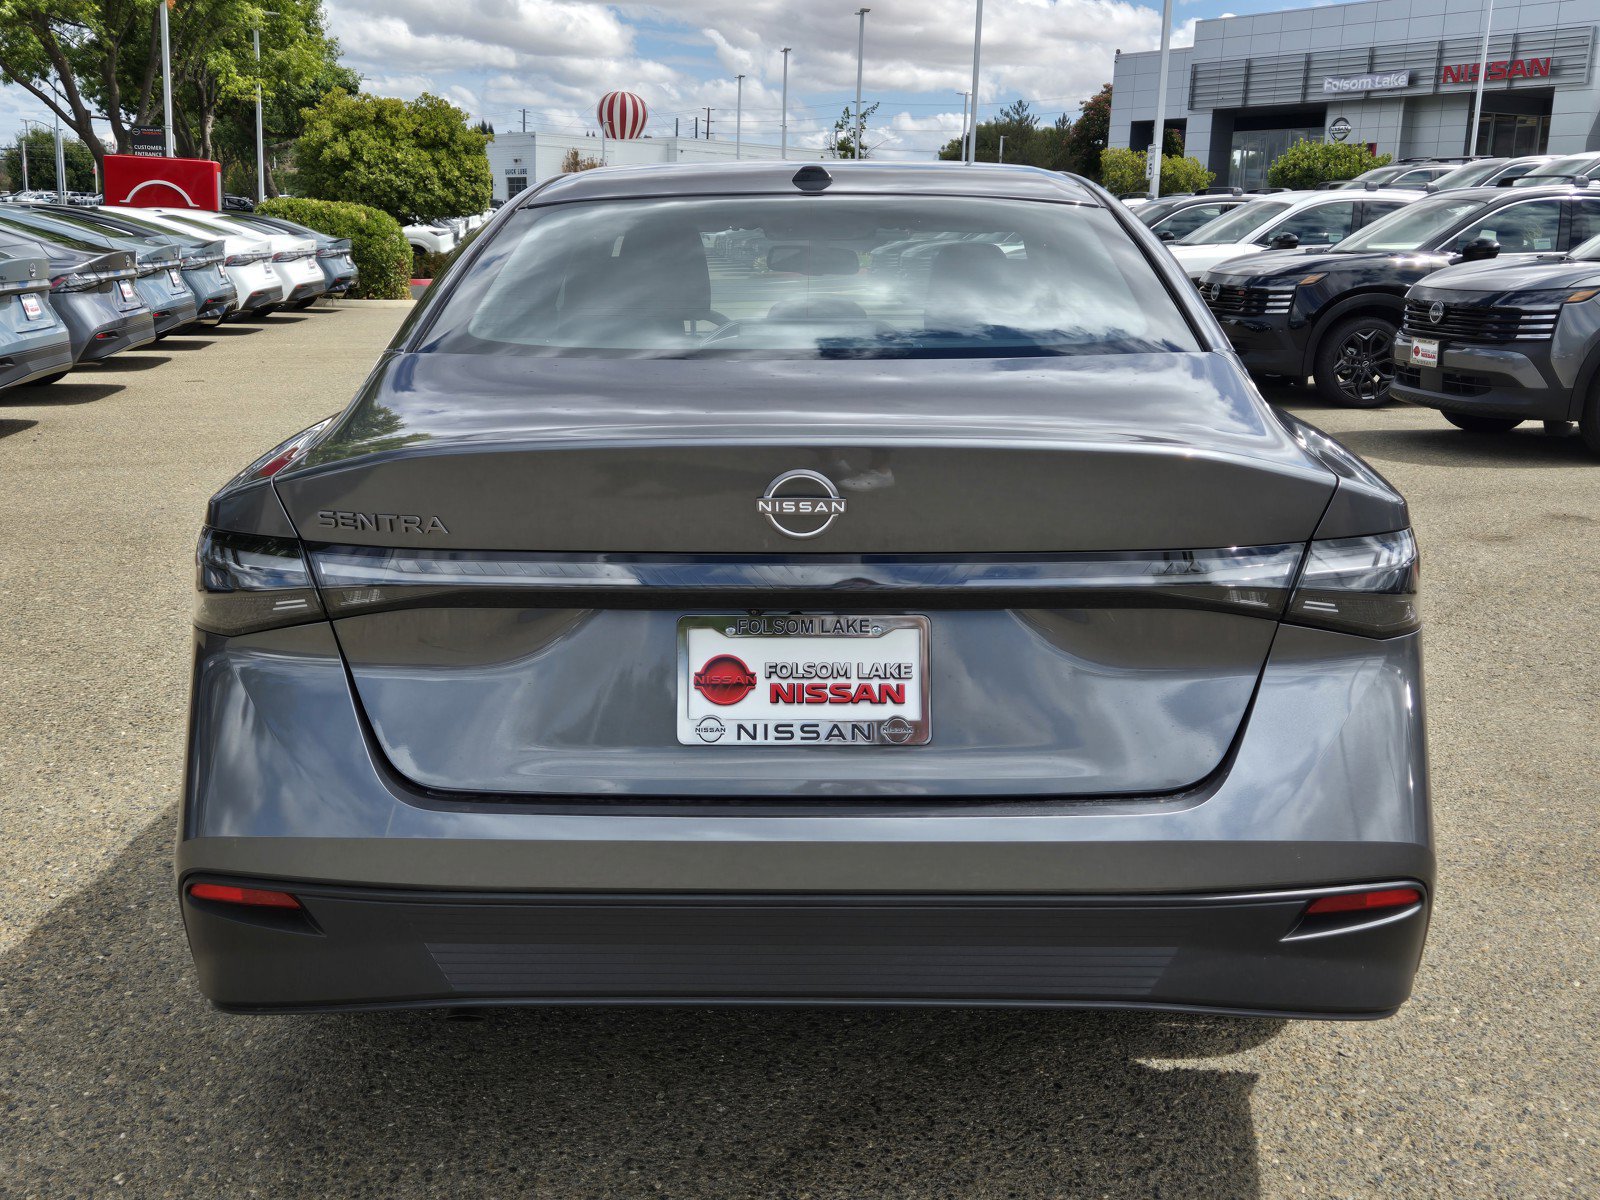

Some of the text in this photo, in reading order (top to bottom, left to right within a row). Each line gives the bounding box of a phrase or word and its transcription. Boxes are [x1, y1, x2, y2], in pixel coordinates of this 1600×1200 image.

[1442, 57, 1551, 84] NISSAN
[1324, 73, 1407, 91] Folsom Lake
[758, 501, 845, 513] NISSAN
[317, 510, 449, 534] SENTRA
[736, 619, 870, 635] FOLSOM LAKE
[764, 662, 913, 679] FOLSOM LAKE
[694, 674, 757, 686] NISSAN
[769, 683, 906, 705] NISSAN
[736, 723, 873, 742] NISSAN
[882, 726, 914, 734] NISSAN
